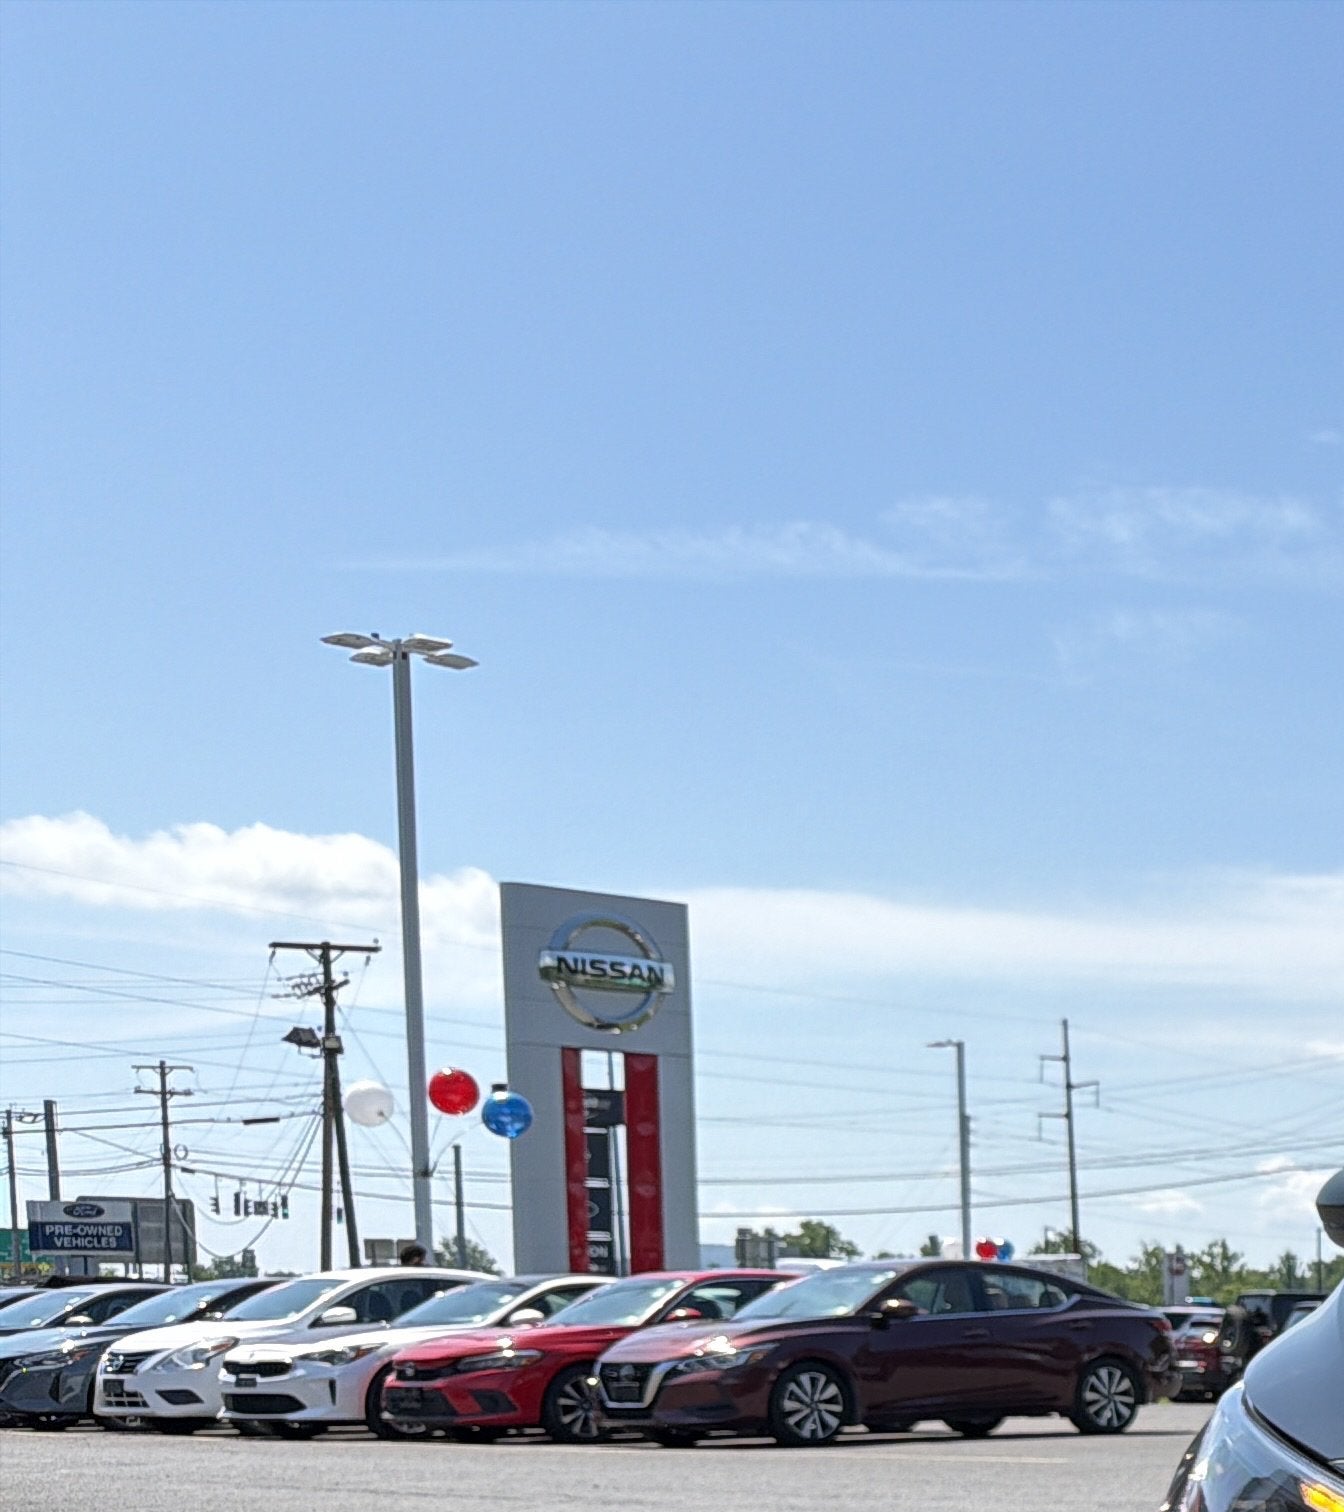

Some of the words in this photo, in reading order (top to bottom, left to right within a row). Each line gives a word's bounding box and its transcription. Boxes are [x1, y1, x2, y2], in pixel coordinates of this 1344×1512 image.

[556, 955, 665, 987] NISSAN
[45, 1224, 123, 1237] PRE-OWNED
[53, 1236, 118, 1249] VEHICLES
